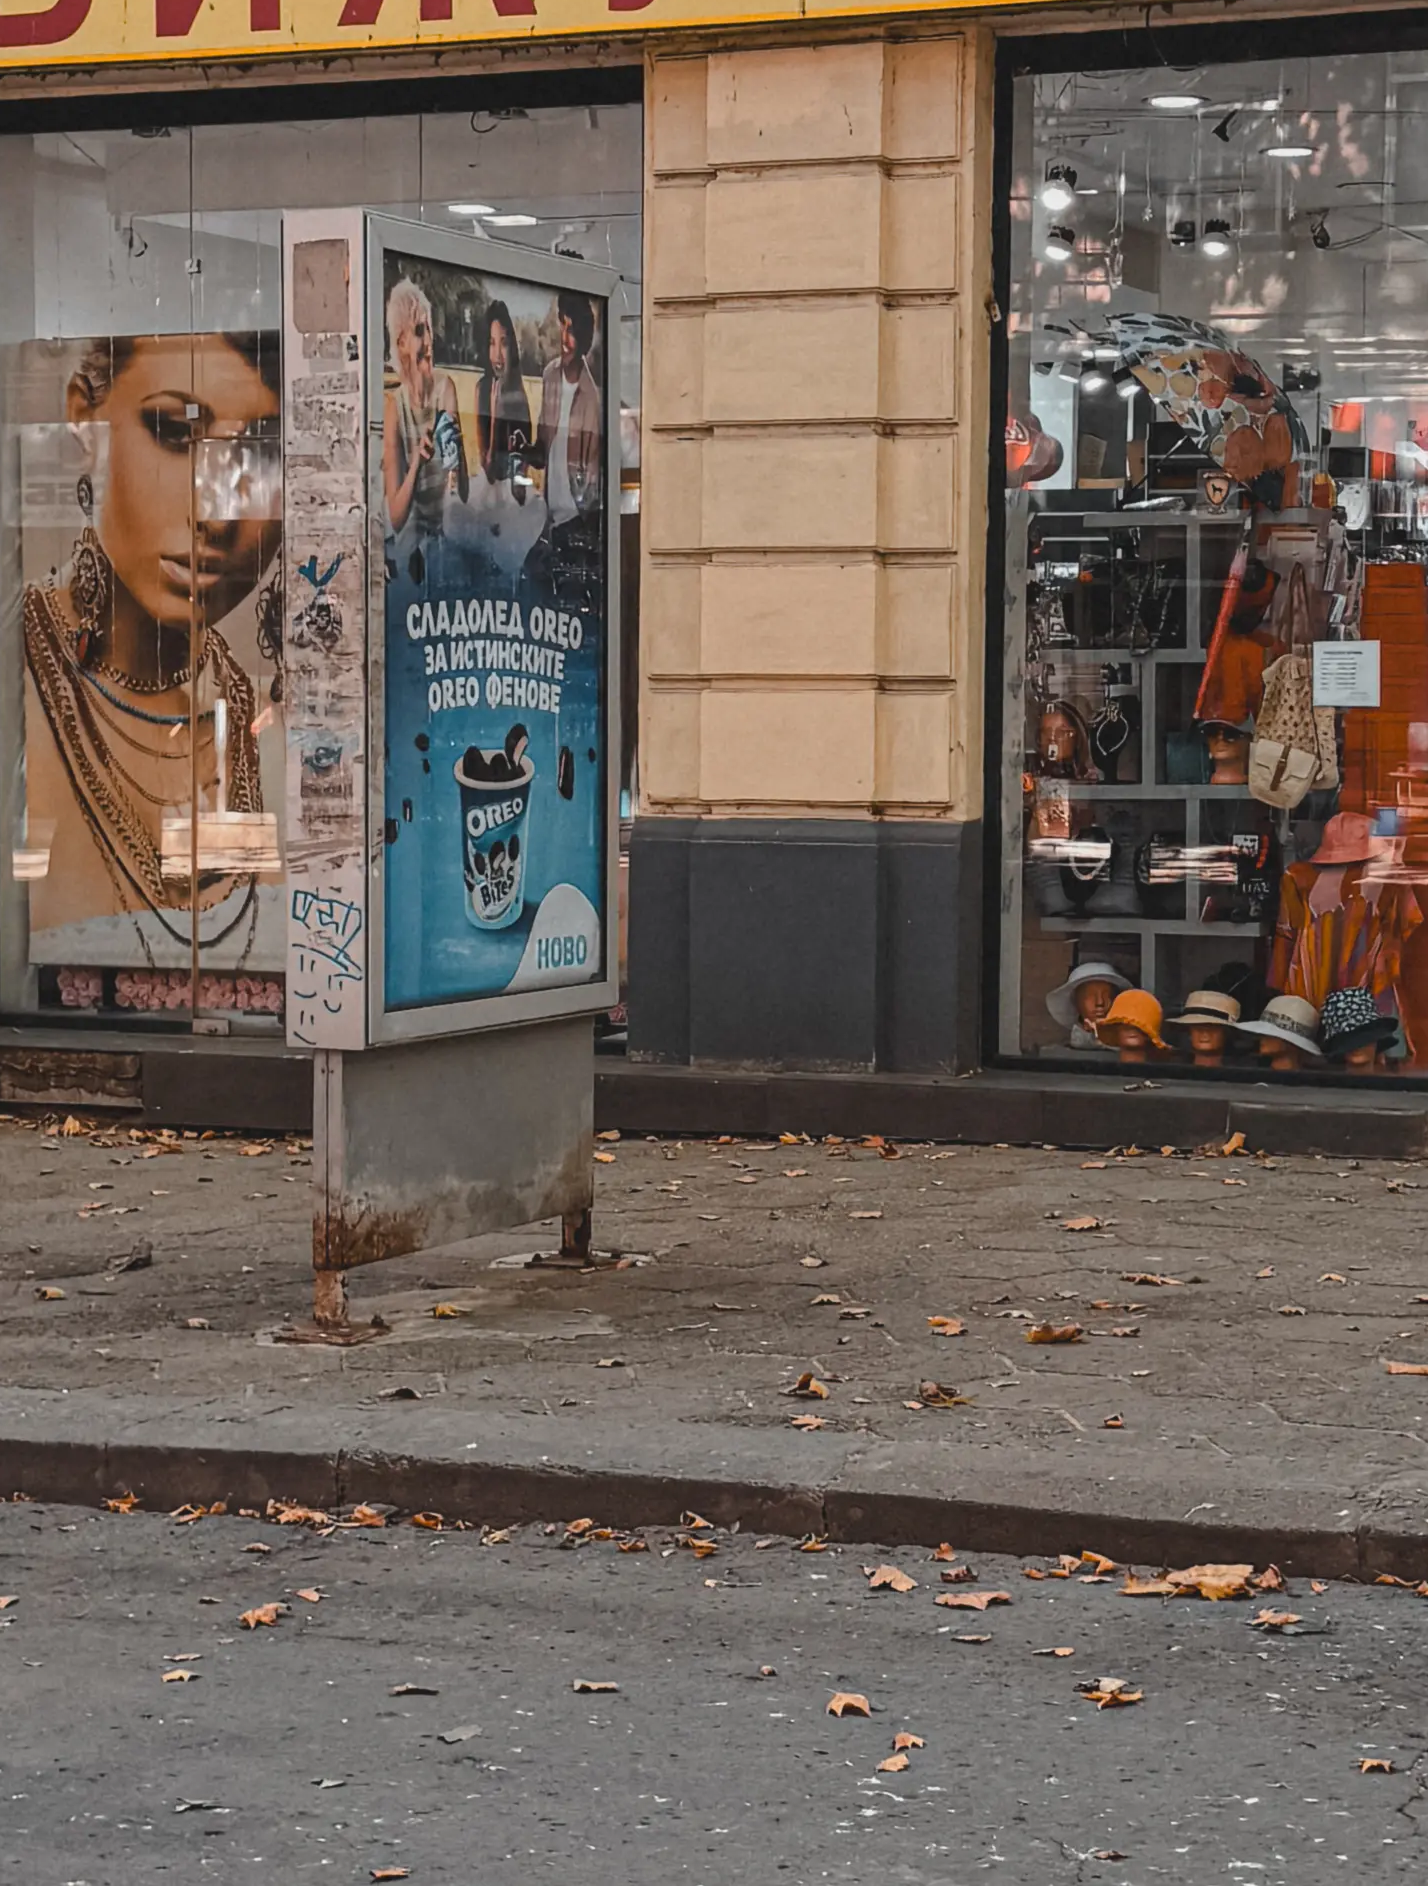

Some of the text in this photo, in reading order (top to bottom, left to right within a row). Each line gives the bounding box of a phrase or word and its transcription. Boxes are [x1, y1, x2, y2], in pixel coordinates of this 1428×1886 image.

[406, 599, 583, 650] СЛАДОЛЕД OREO
[424, 639, 565, 680] ЗА ИСТИНСКИТЕ
[428, 672, 561, 714] OREO ФЕНОВЕ
[467, 798, 523, 837] OREO
[538, 935, 587, 970] НОВО
